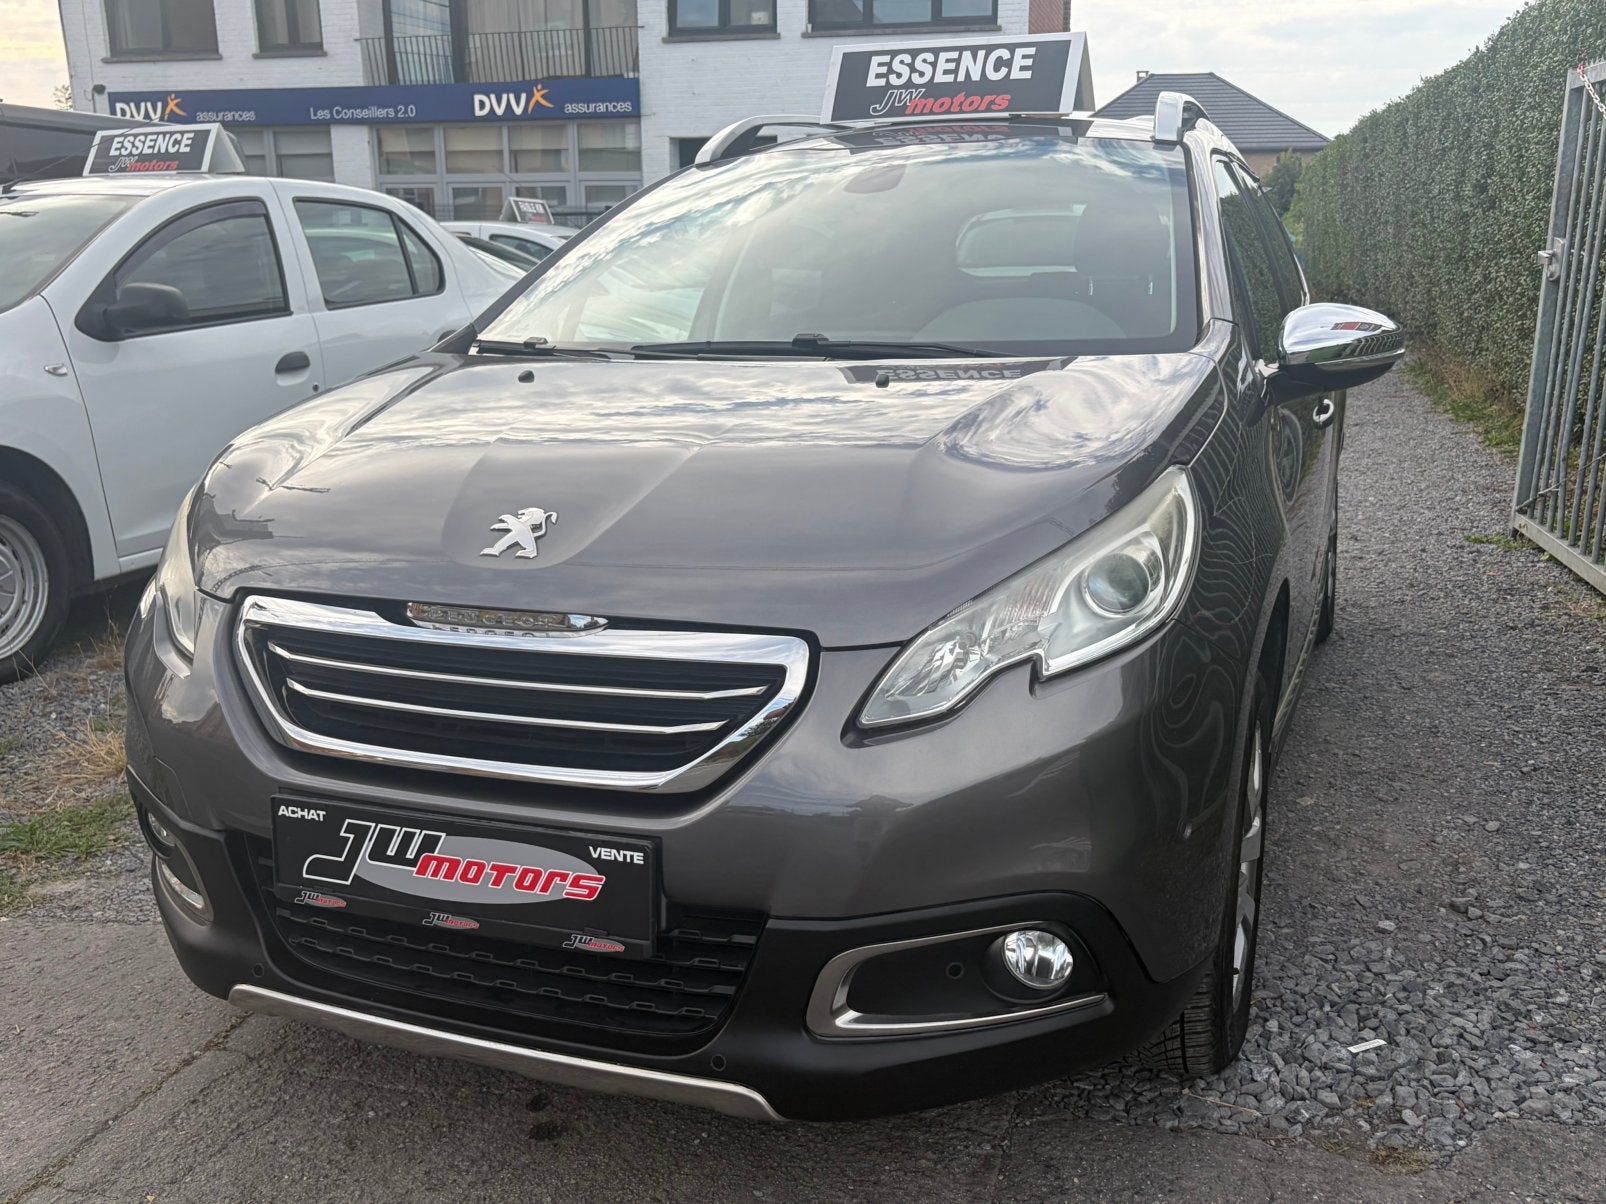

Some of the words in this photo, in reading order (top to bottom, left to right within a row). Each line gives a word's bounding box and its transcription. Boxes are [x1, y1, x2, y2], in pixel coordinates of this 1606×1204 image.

[866, 47, 1036, 87] ESSENCE
[115, 101, 163, 122] DVV
[196, 110, 256, 121] assurances
[310, 107, 331, 119] Les
[333, 105, 395, 119] Conseillers
[397, 104, 416, 117] 2.0
[473, 93, 527, 117] DVV
[564, 101, 632, 113] assurances
[109, 132, 194, 156] ESSENCE
[127, 159, 179, 171] motors
[278, 805, 326, 822] ACHAT
[589, 846, 644, 864] VENTE
